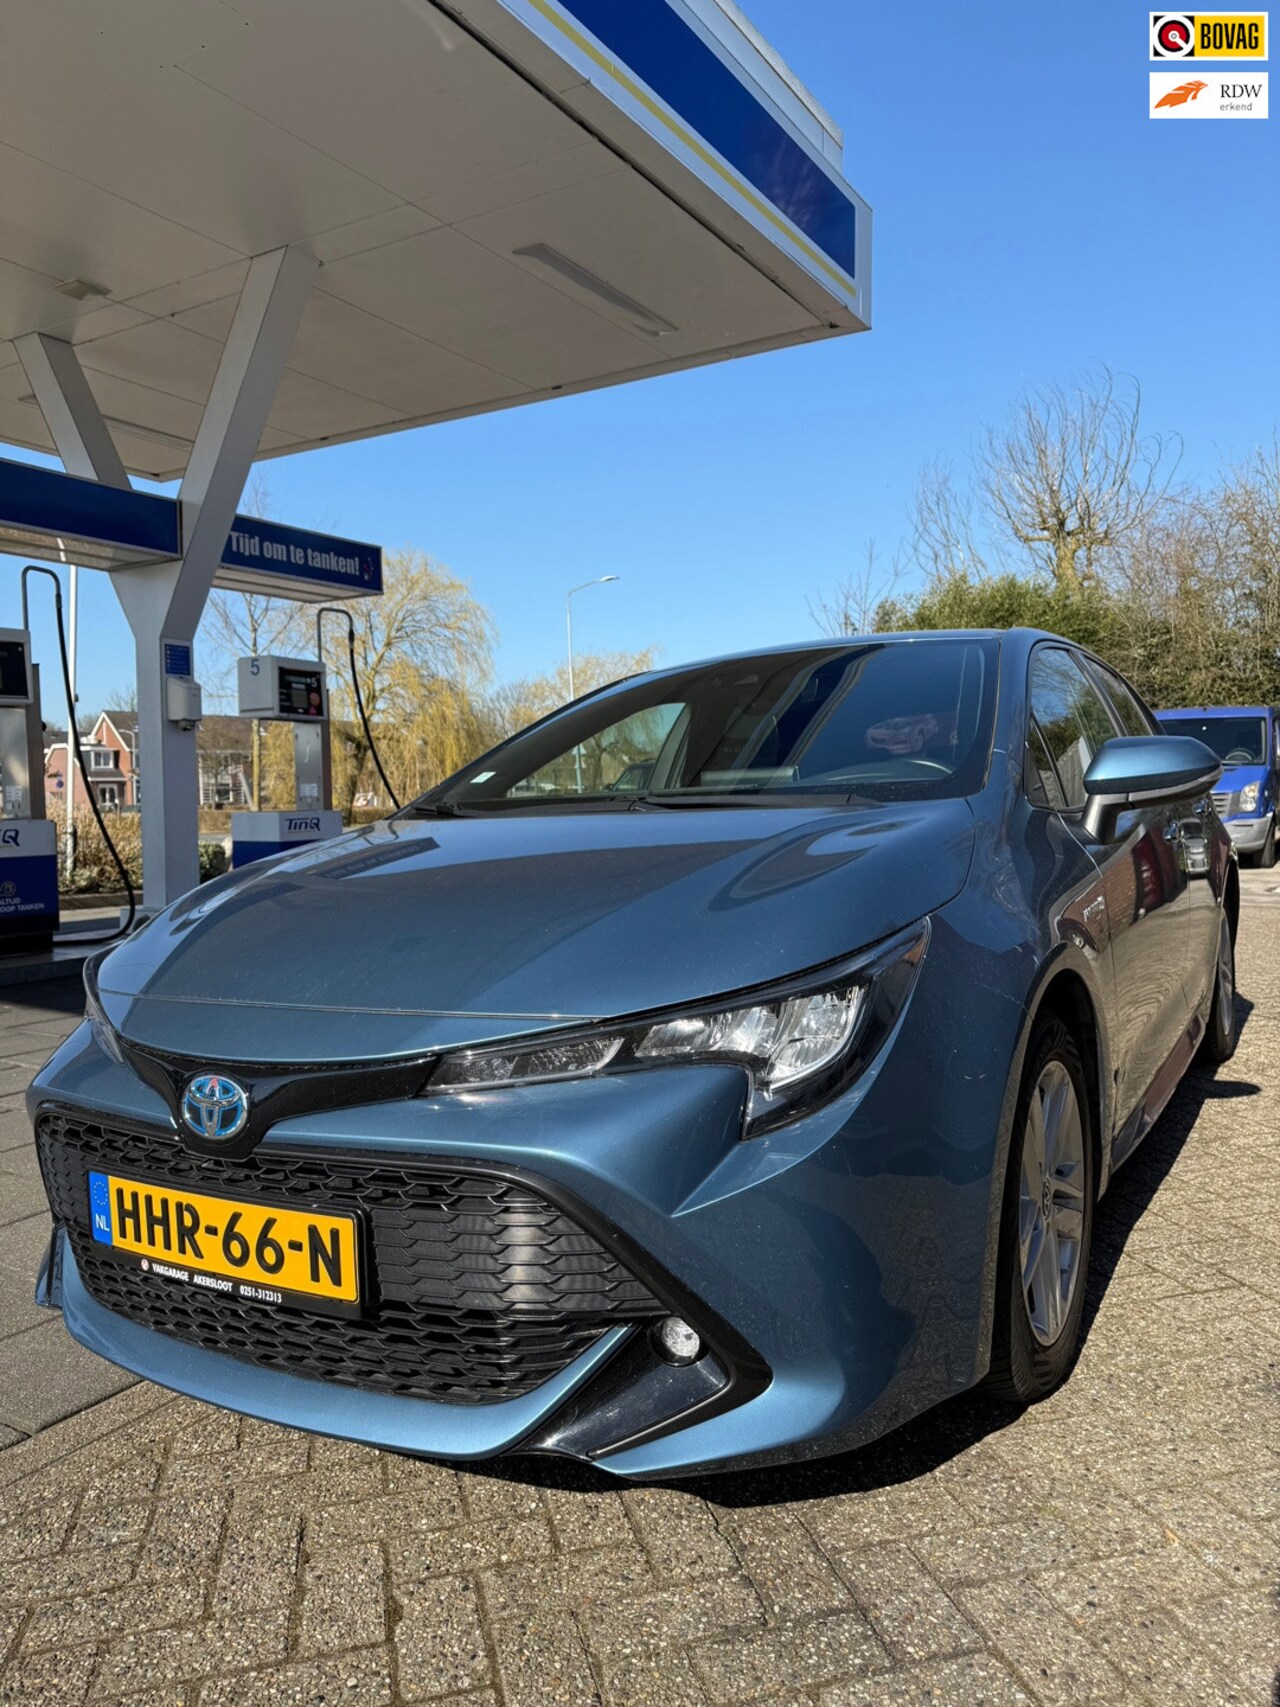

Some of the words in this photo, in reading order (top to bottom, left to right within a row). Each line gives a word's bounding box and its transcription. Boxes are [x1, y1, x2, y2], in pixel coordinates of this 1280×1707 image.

[230, 531, 260, 557] Tijd
[263, 540, 288, 562] om
[289, 544, 305, 565] te
[307, 548, 360, 576] tanken!
[250, 659, 260, 676] 5
[17, 902, 45, 911] TANKEN
[95, 1213, 110, 1232] NL
[116, 1187, 342, 1288] HHR-66-N
[152, 1263, 190, 1282] VAKGARAGE
[193, 1274, 233, 1292] AKERSLOOT
[239, 1285, 282, 1304] 0251-312313
